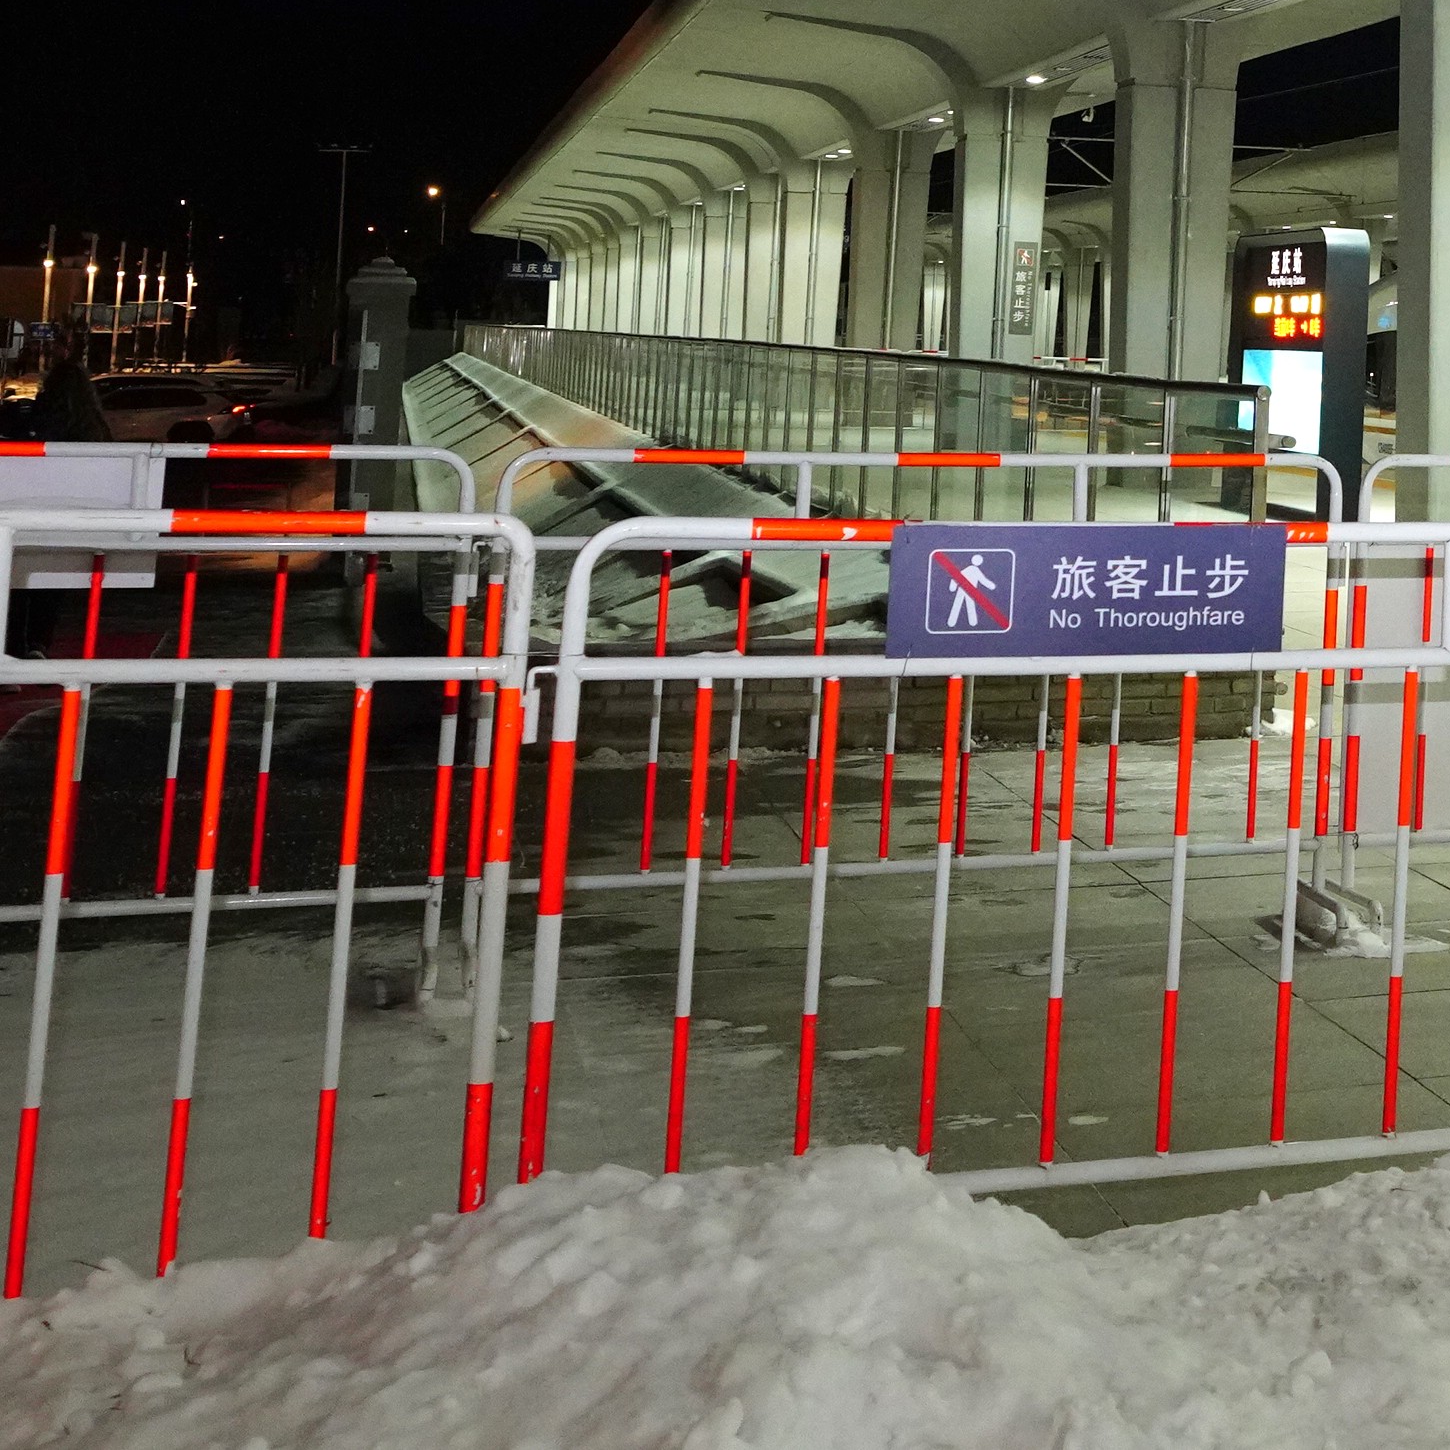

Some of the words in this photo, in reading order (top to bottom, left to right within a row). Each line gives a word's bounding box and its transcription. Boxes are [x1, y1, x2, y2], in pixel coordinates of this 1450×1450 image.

[511, 263, 553, 273] 延庆站
[1013, 270, 1027, 322] 旅客止步
[1050, 553, 1250, 601] 旅客止步
[1049, 608, 1081, 629] No
[1094, 606, 1245, 631] Thoroughfare
